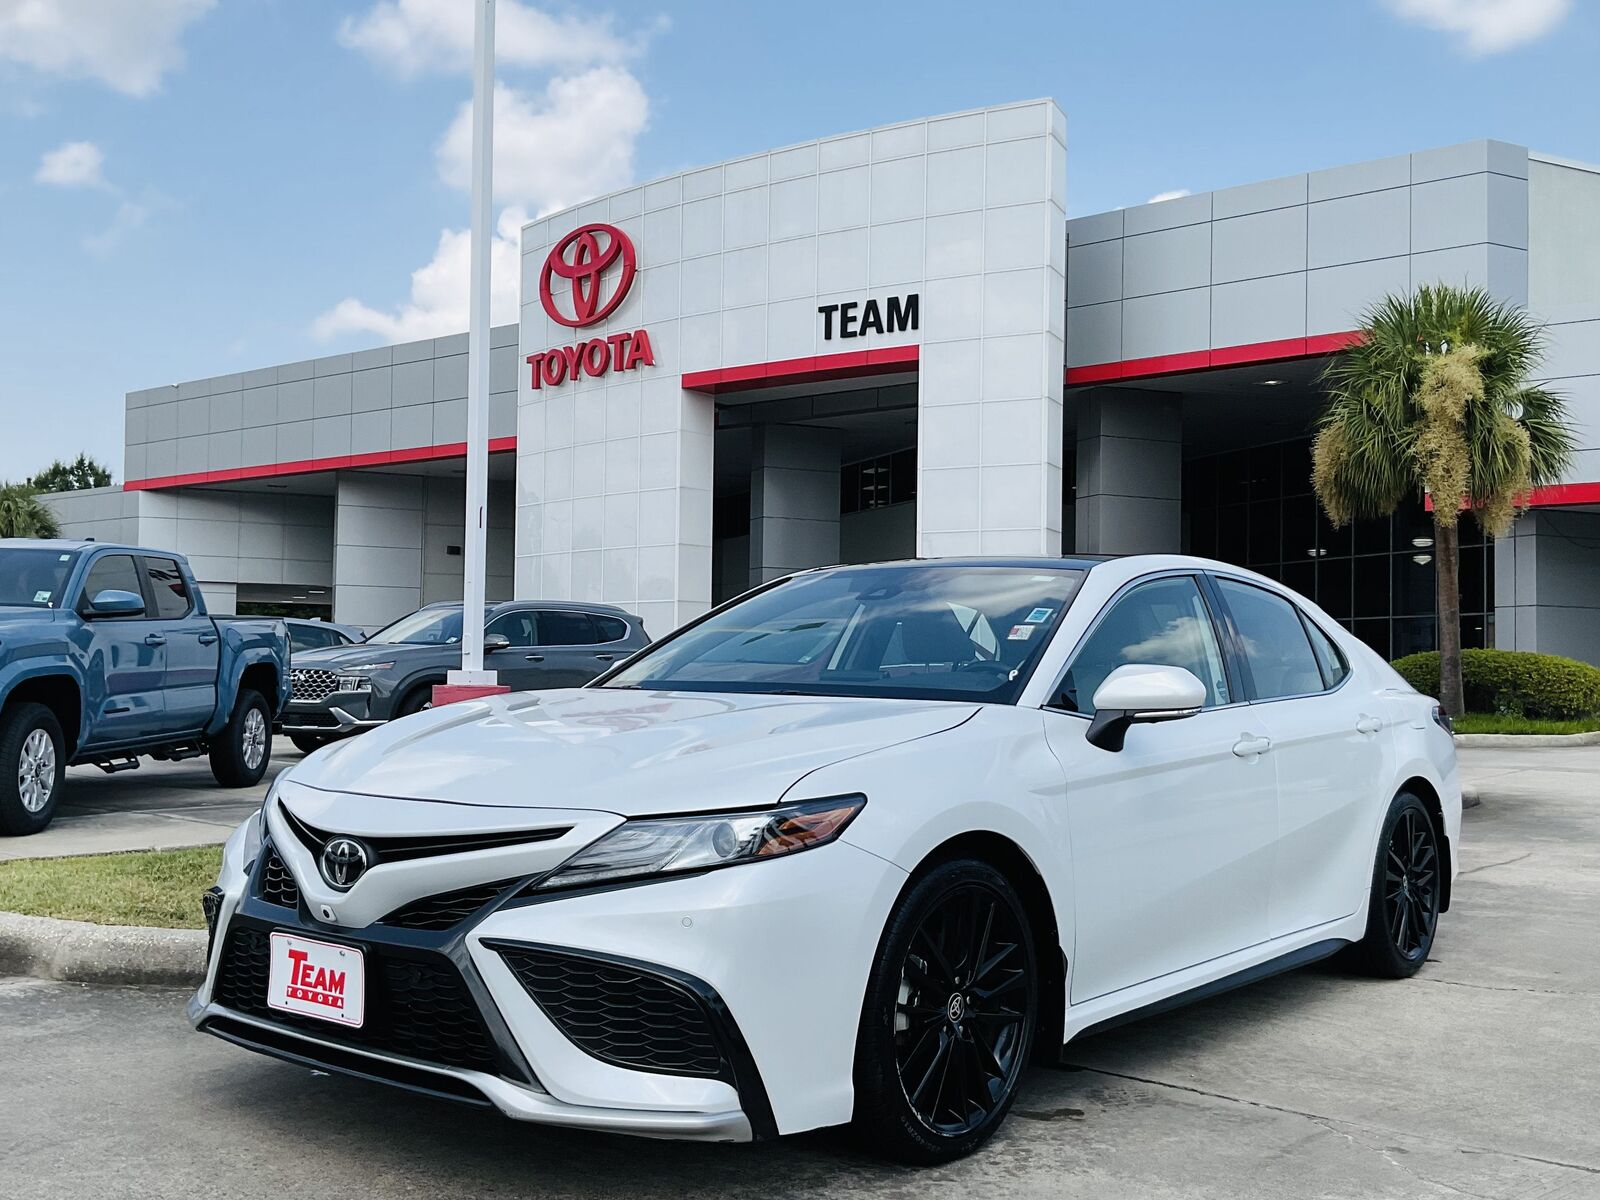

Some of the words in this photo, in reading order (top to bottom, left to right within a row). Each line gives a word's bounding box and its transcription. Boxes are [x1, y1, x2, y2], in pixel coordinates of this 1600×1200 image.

[817, 293, 920, 340] TEAM
[526, 328, 656, 390] TOYOTA
[288, 948, 346, 995] TEAM
[287, 987, 344, 1007] TOYOTA
